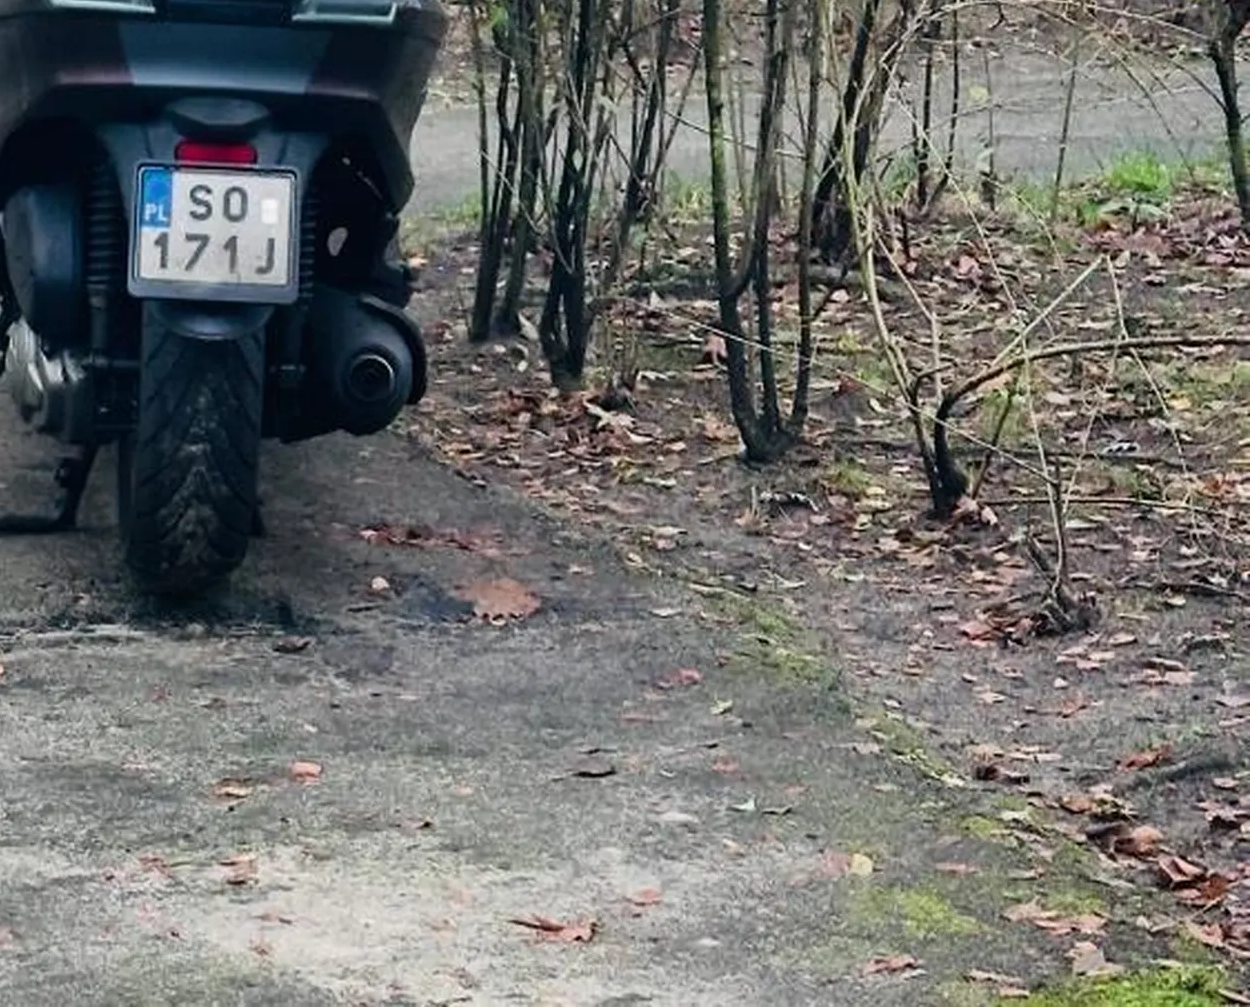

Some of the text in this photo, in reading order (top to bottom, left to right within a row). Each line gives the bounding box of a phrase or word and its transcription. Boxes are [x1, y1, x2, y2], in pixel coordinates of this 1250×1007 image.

[144, 203, 168, 221] PL
[189, 184, 249, 223] SO
[153, 231, 276, 275] 171J
